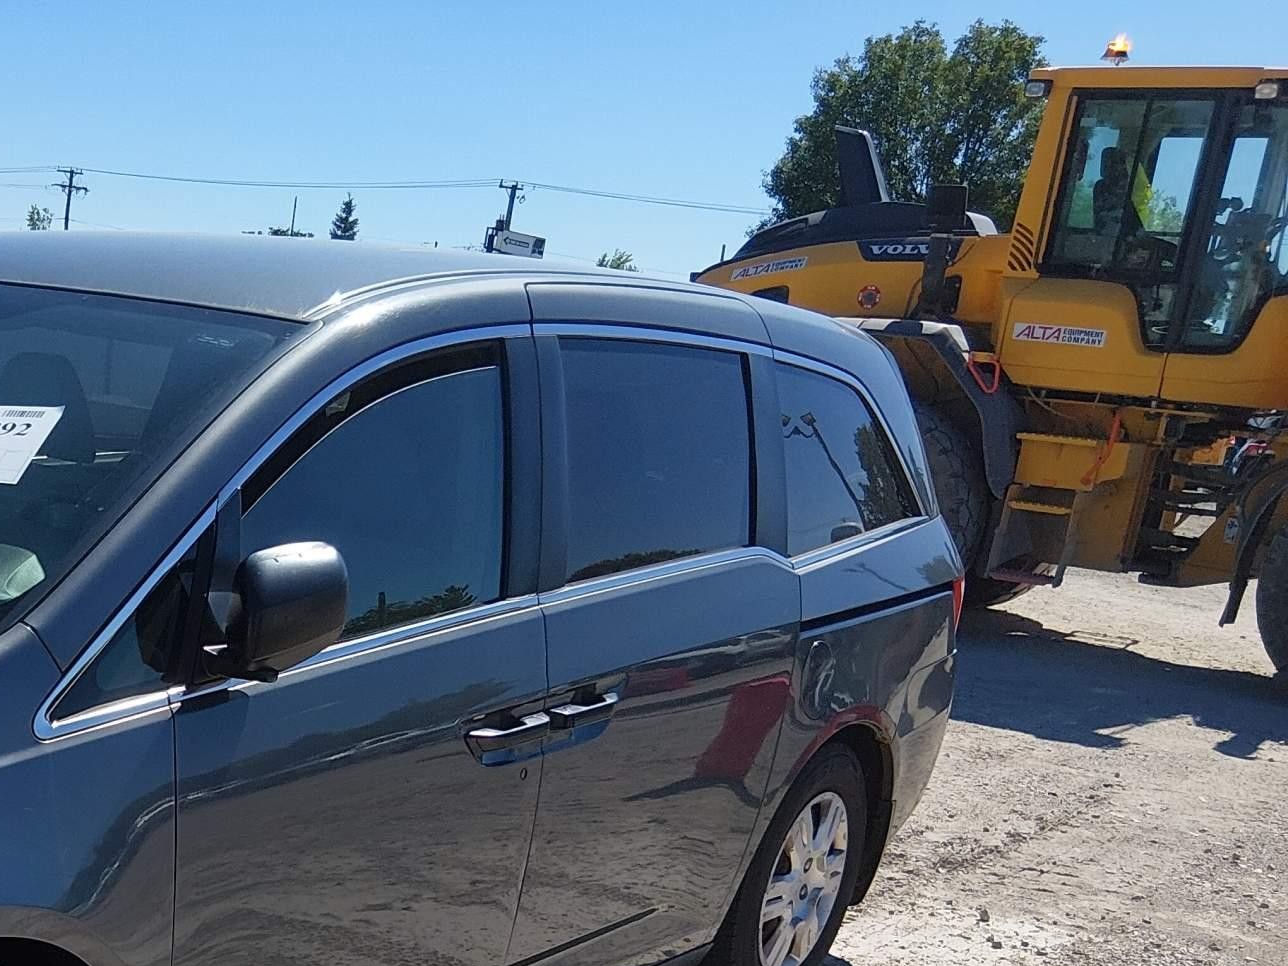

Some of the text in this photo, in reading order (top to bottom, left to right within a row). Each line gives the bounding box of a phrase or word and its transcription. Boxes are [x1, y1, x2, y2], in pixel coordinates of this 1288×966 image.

[870, 244, 930, 254] VOLV
[734, 263, 770, 280] ALTA
[1015, 325, 1062, 342] ALTA
[1063, 328, 1105, 338] EQUIPMENT
[1061, 335, 1103, 346] COMPANY
